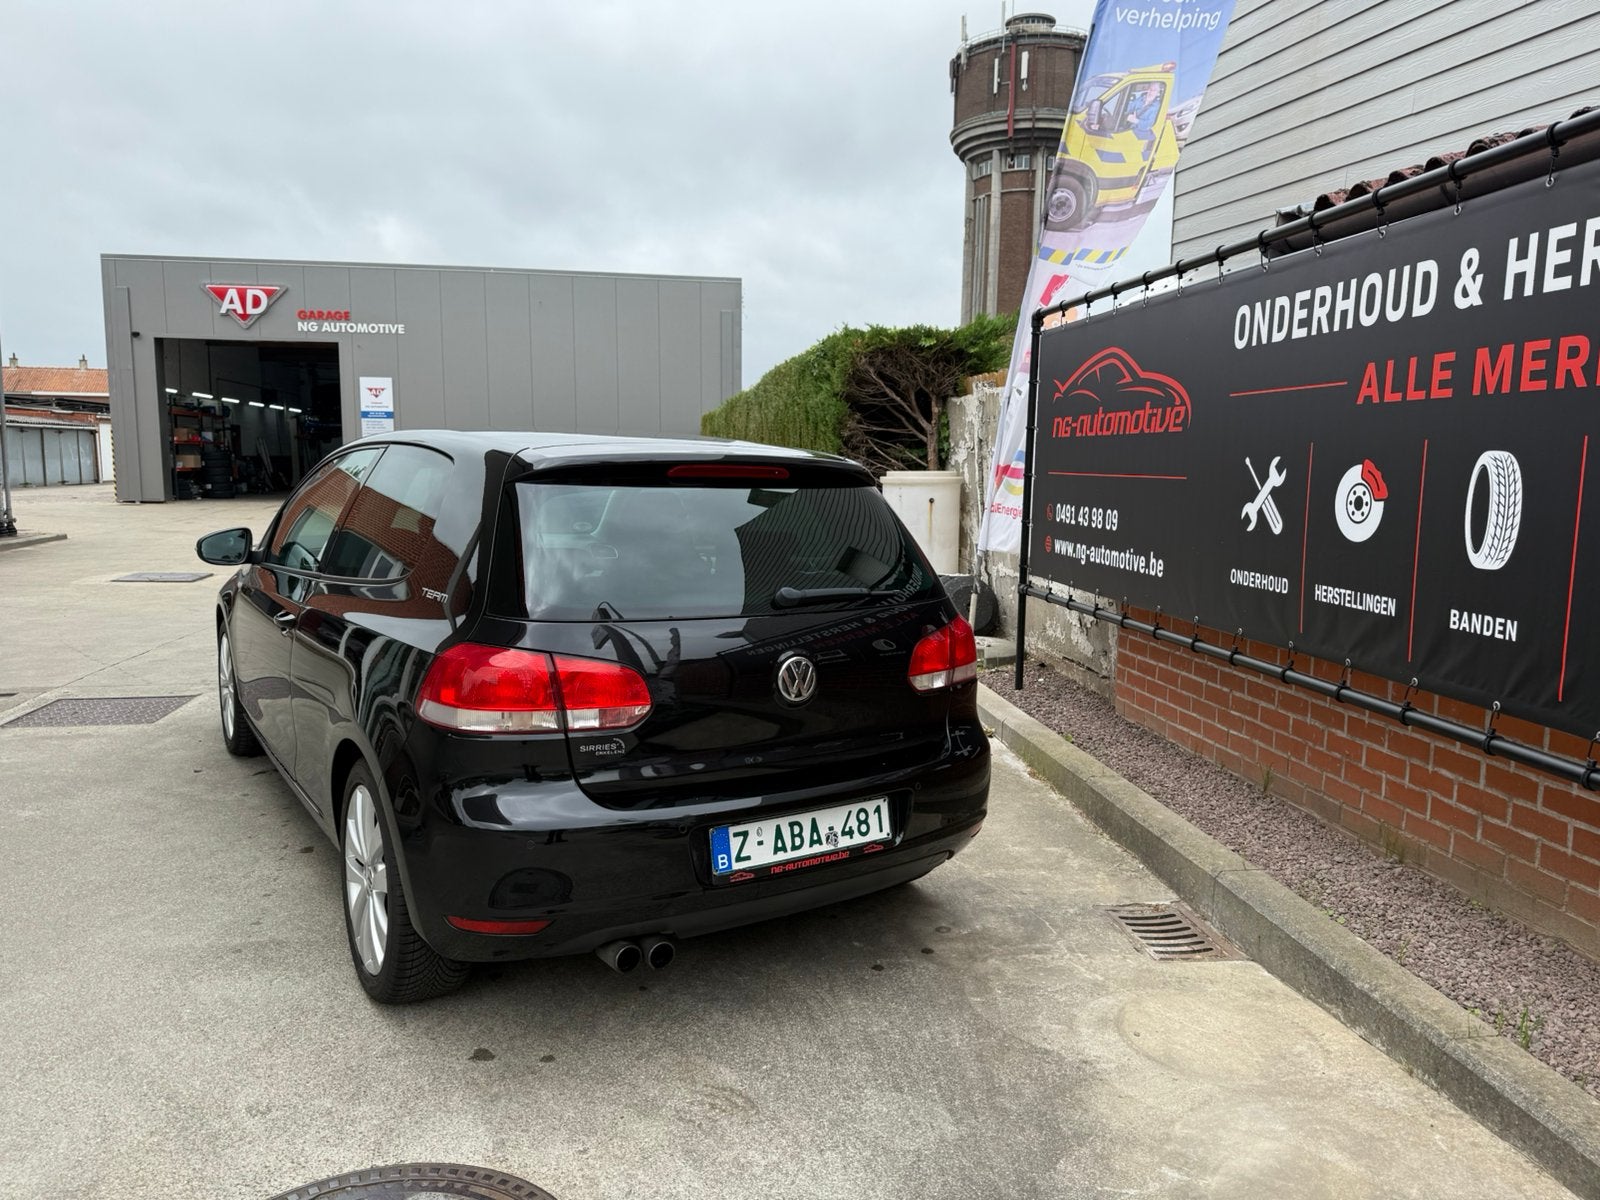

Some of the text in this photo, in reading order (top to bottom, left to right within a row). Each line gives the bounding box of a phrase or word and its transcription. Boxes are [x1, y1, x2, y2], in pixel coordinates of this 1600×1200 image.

[1116, 7, 1222, 32] verhelping
[219, 288, 268, 315] AD
[1233, 259, 1439, 350] ONDERHOUD
[1453, 247, 1484, 310] &
[297, 309, 351, 321] GARAGE
[297, 322, 405, 334] NG AUTOMOTIVE
[1356, 335, 1600, 405] ALLE MER
[1056, 503, 1119, 531] 0491 43 98 09
[1054, 537, 1164, 578] www.ng-automotive.be
[1230, 568, 1289, 594] ONDERHOUD
[422, 587, 448, 603] TEAM
[1314, 584, 1397, 617] HERSTELLINGEN
[1450, 608, 1518, 642] BANDEN
[579, 742, 617, 753] SIRRIES
[717, 854, 729, 869] B
